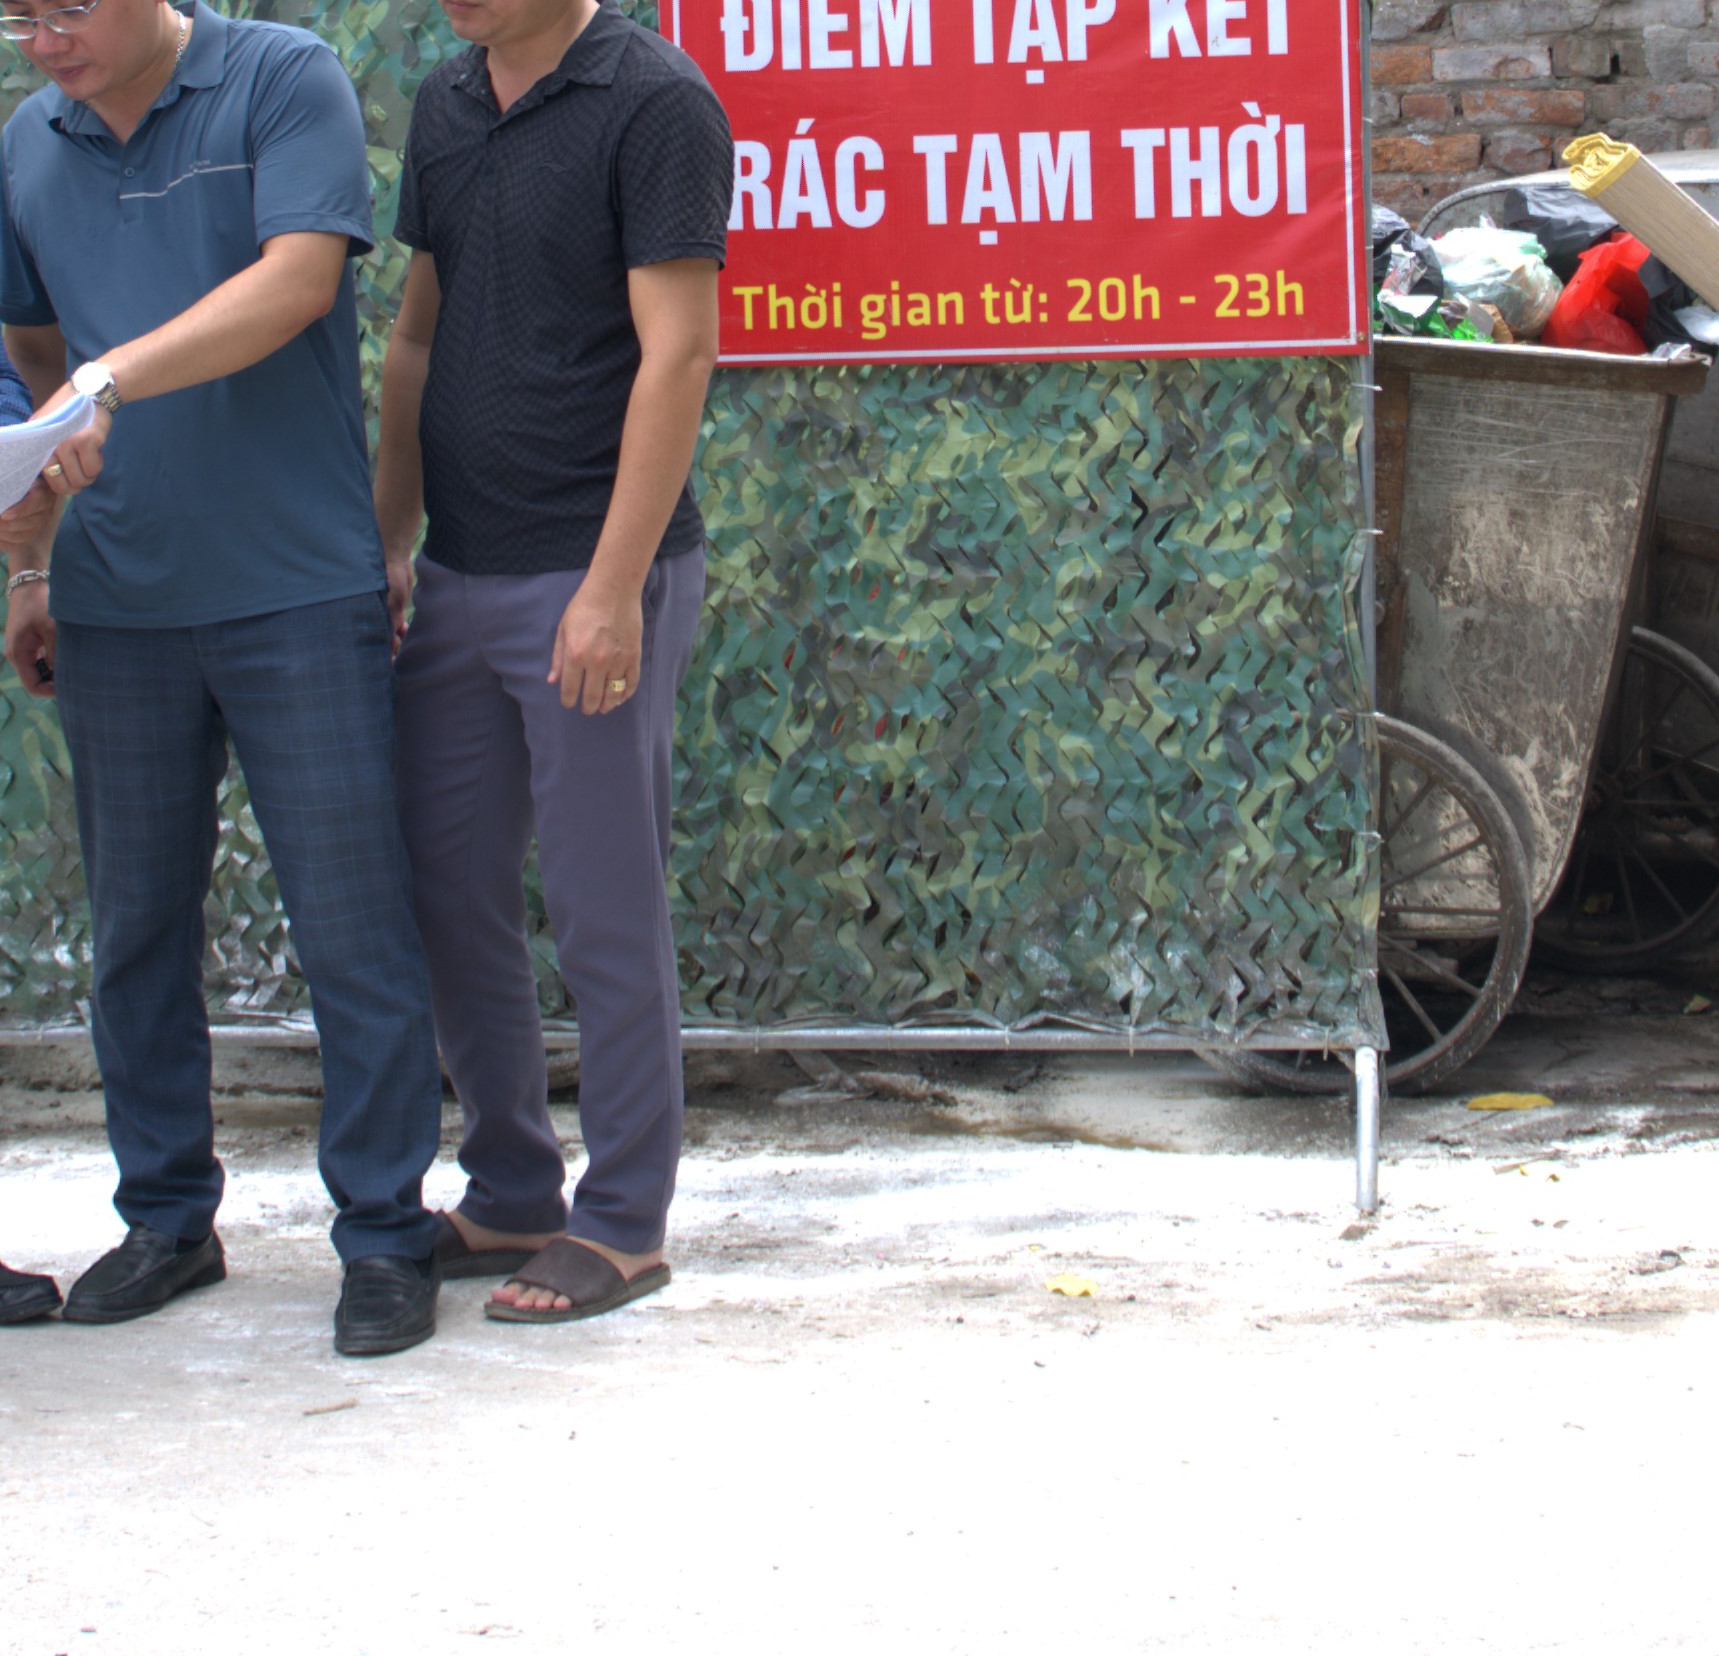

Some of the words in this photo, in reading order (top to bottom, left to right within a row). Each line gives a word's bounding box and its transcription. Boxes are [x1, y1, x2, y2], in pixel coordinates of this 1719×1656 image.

[728, 118, 885, 230] RÁC
[913, 130, 1094, 245] TẠM
[1121, 101, 1308, 220] THỜI
[733, 282, 843, 331] Thời
[860, 285, 965, 341] gian
[980, 278, 1049, 326] từ:
[1066, 273, 1161, 323] 20h
[1215, 270, 1305, 319] 23h
